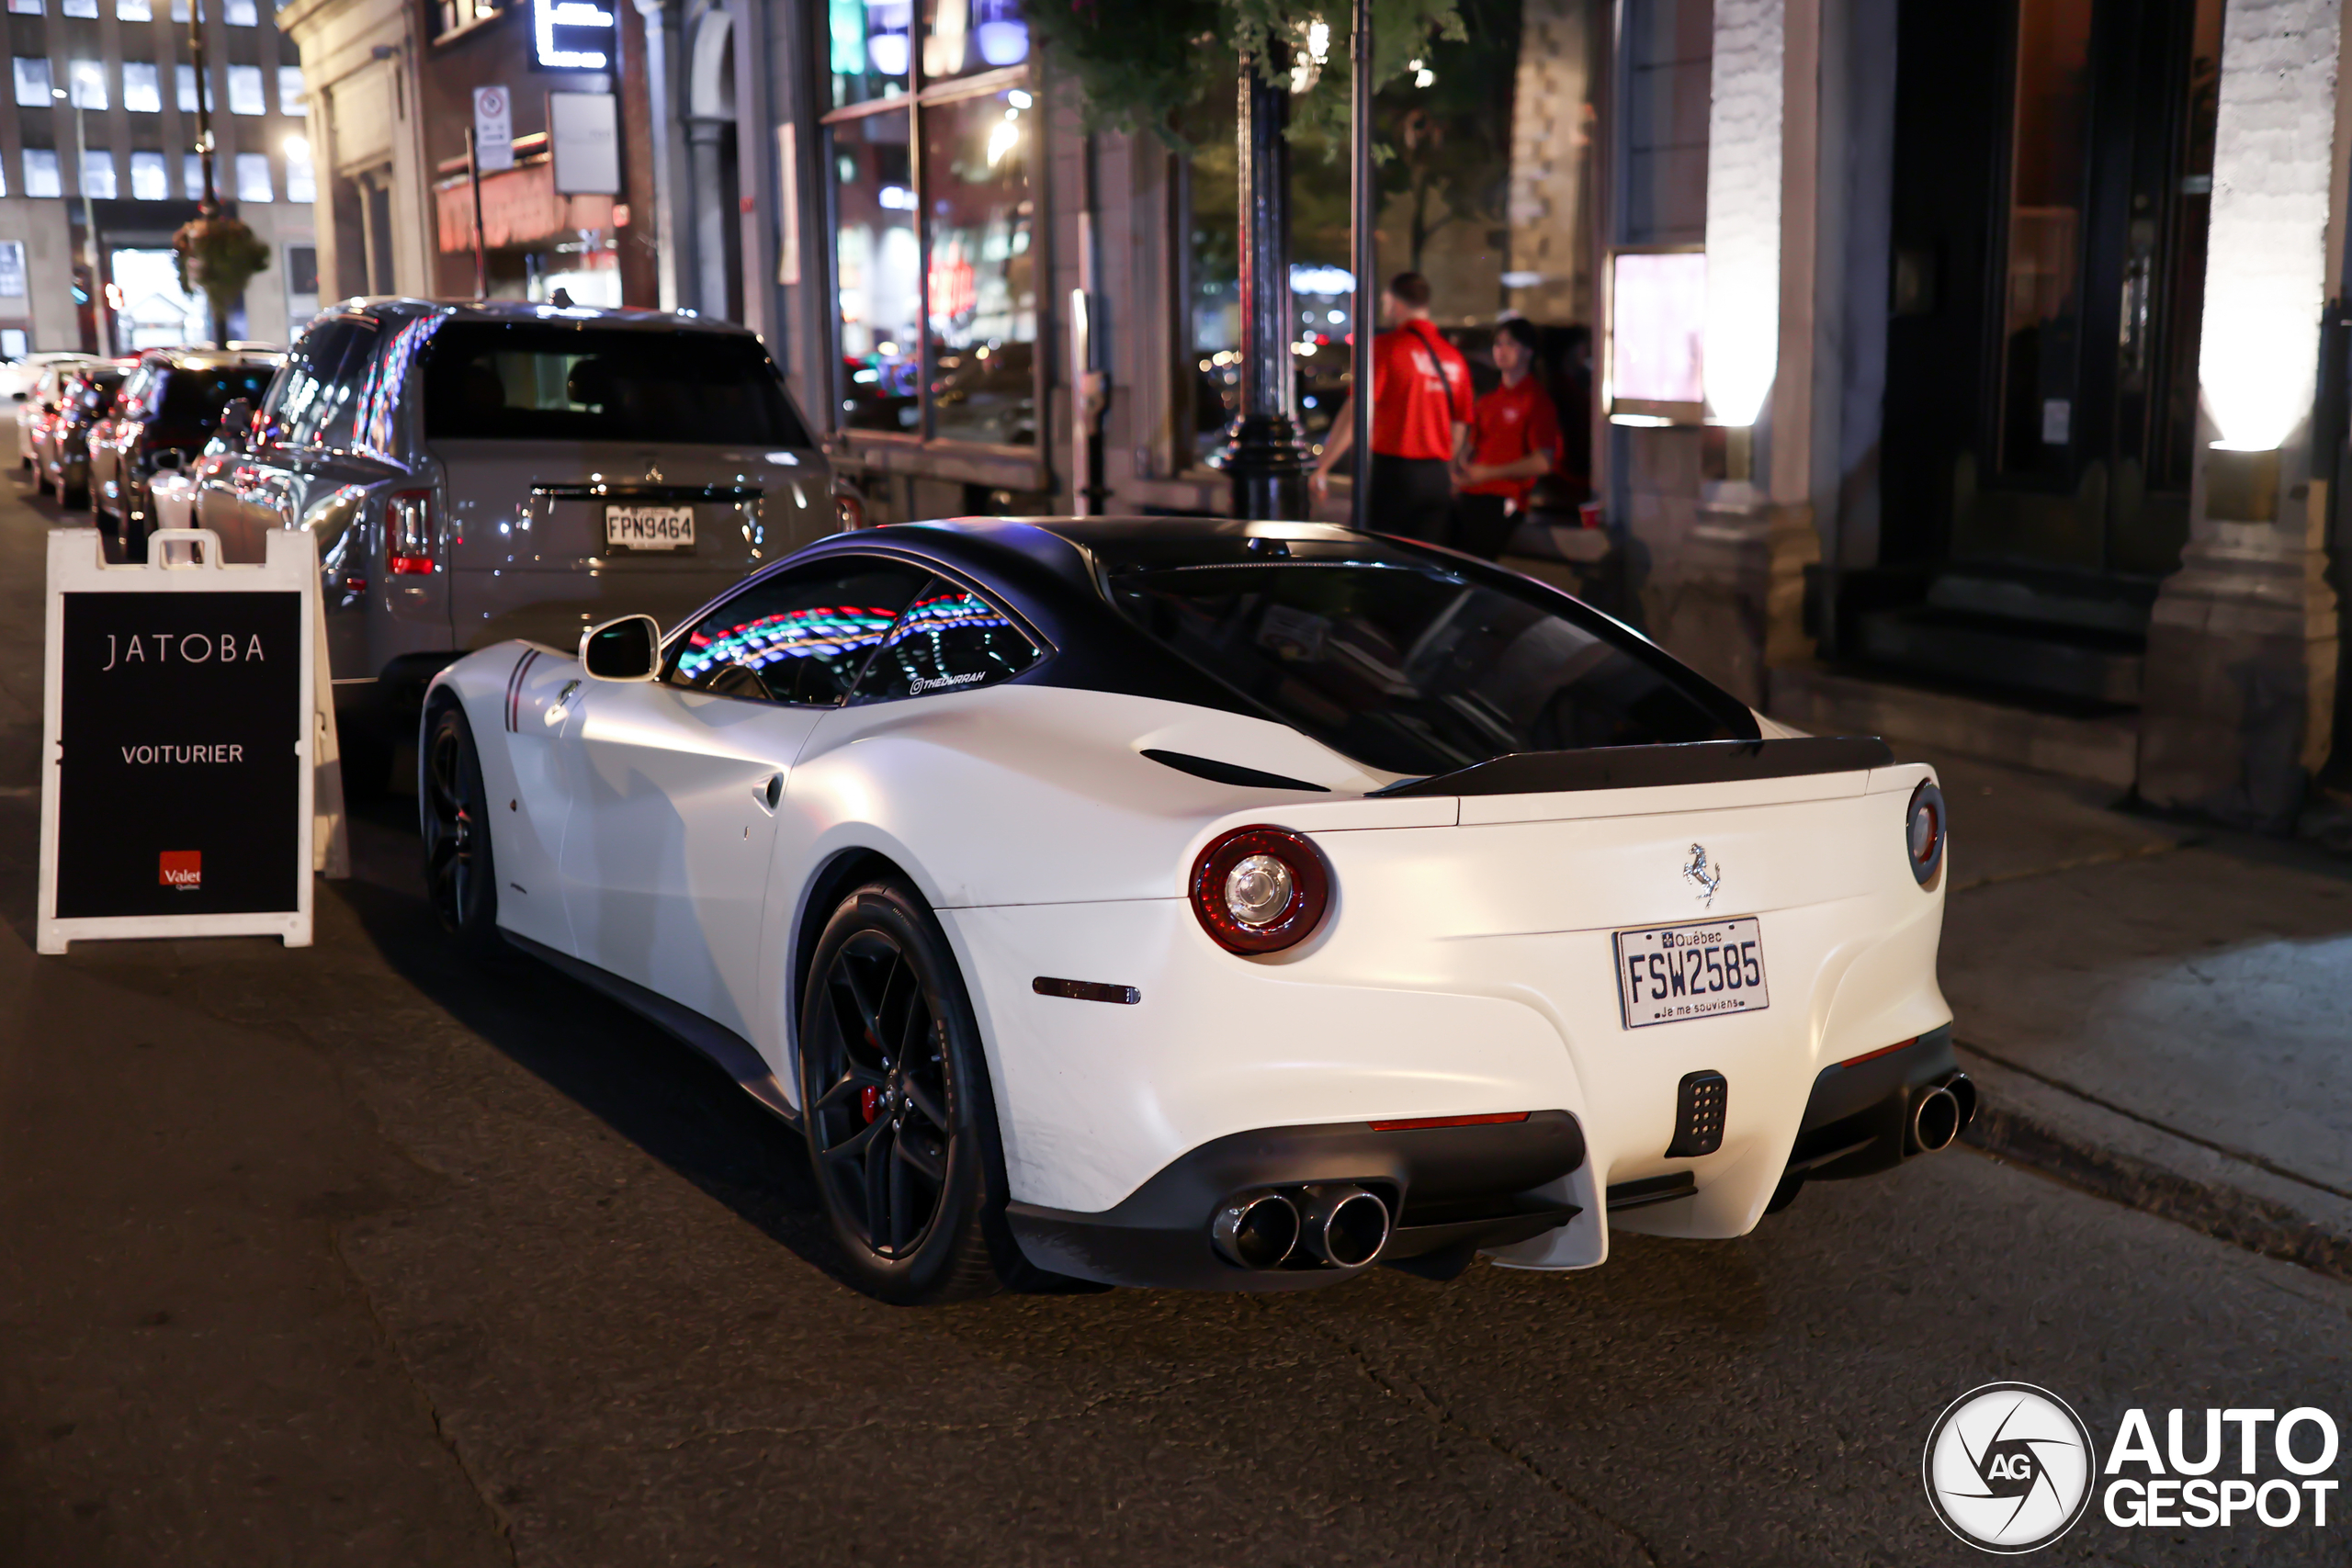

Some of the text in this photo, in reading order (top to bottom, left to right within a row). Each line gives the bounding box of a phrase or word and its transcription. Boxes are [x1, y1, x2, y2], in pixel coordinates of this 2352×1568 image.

[608, 516, 691, 539] FPN9464
[102, 633, 266, 671] JATOBA
[922, 671, 987, 690] THEDURRAH
[121, 744, 243, 764] VOITURIER
[164, 869, 201, 883] Valet
[1675, 931, 1723, 947] Québec
[1628, 941, 1760, 1004] FSW2585
[1661, 998, 1738, 1018] Je me souviens
